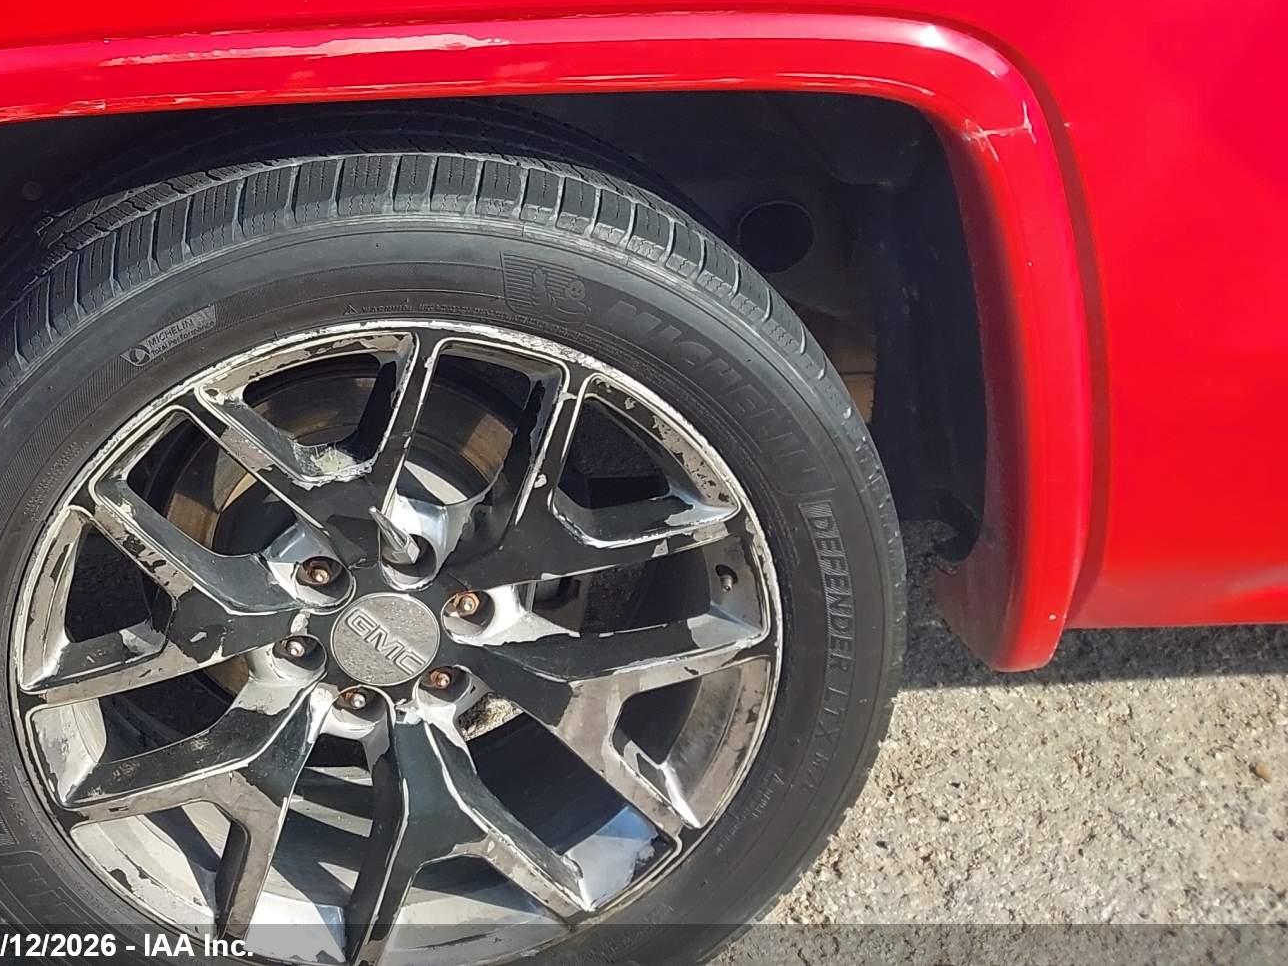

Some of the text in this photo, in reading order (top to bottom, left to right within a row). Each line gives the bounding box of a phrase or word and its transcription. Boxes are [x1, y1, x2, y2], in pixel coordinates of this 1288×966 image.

[148, 319, 193, 346] MICHELIN
[812, 515, 854, 672] DEFENDER
[345, 608, 426, 676] GMC
